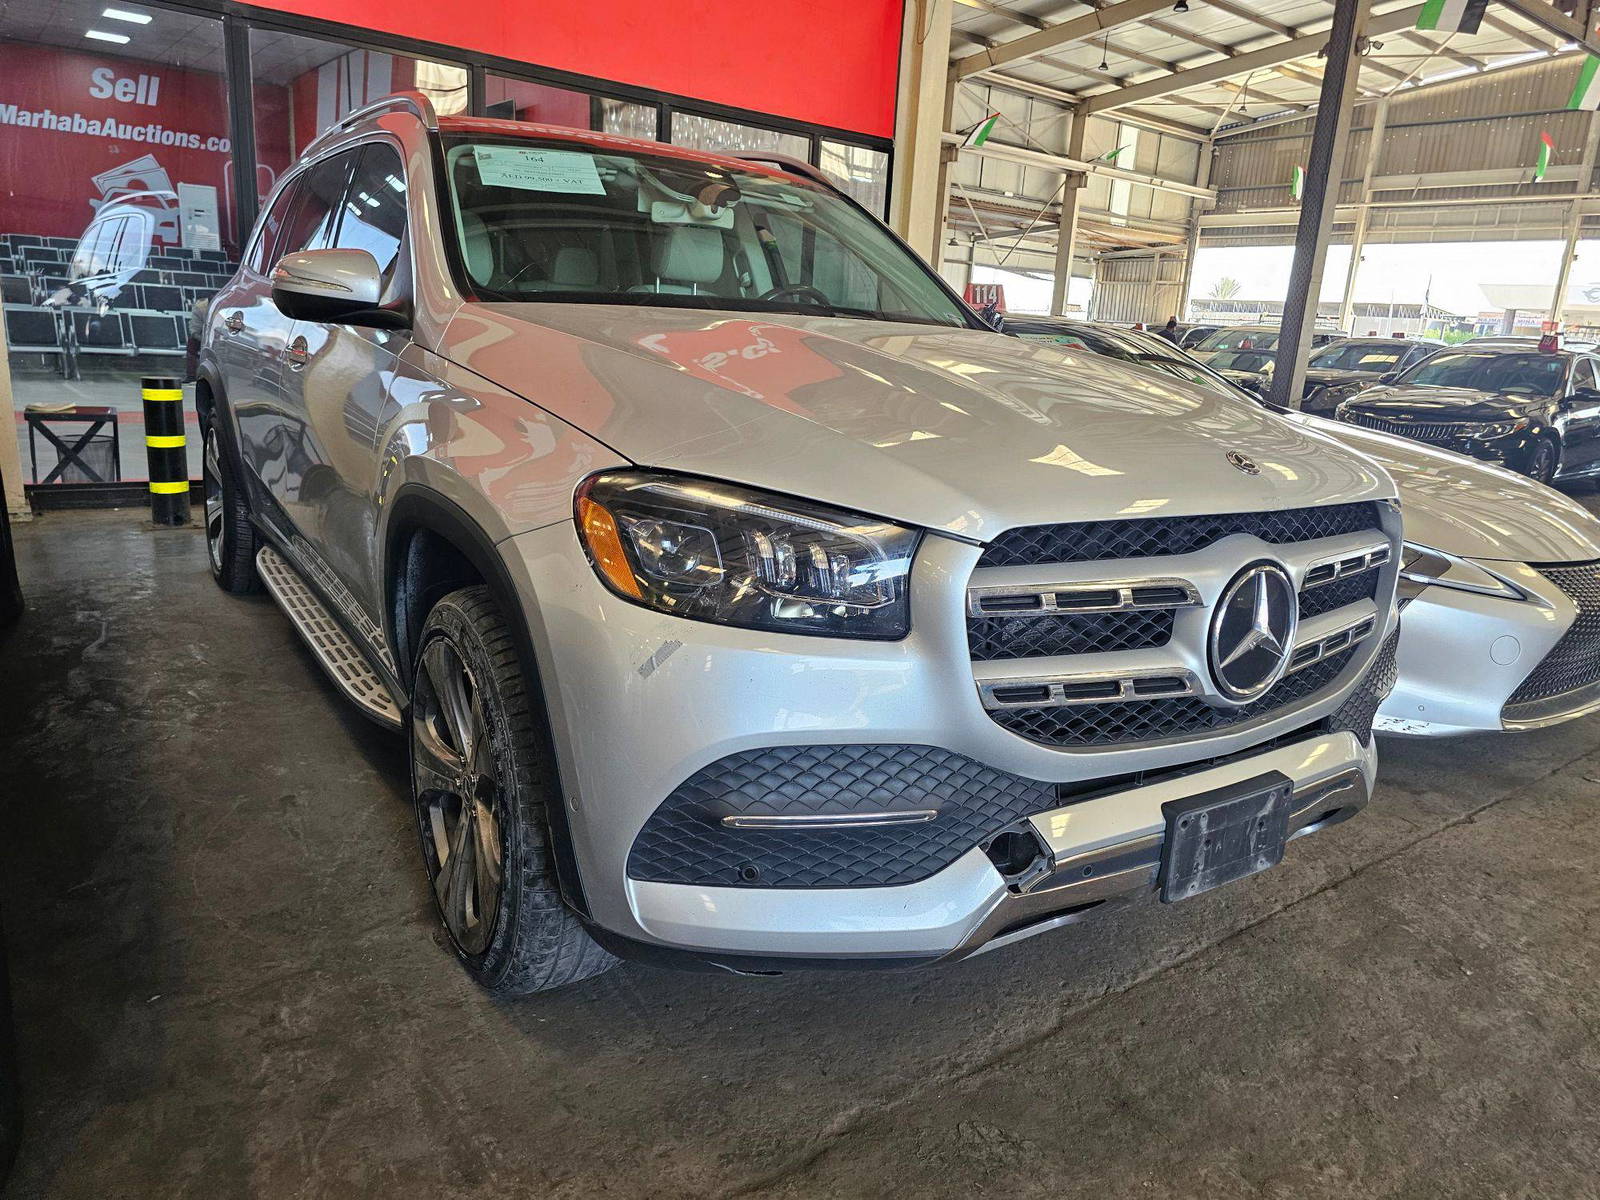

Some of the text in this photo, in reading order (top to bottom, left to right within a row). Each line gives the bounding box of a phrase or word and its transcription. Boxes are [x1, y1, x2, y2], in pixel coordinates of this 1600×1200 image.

[89, 67, 160, 106] Sell
[0, 103, 233, 153] MarhabaAuctions.co
[525, 155, 544, 163] 164
[562, 177, 585, 185] VAT
[975, 285, 997, 304] 114
